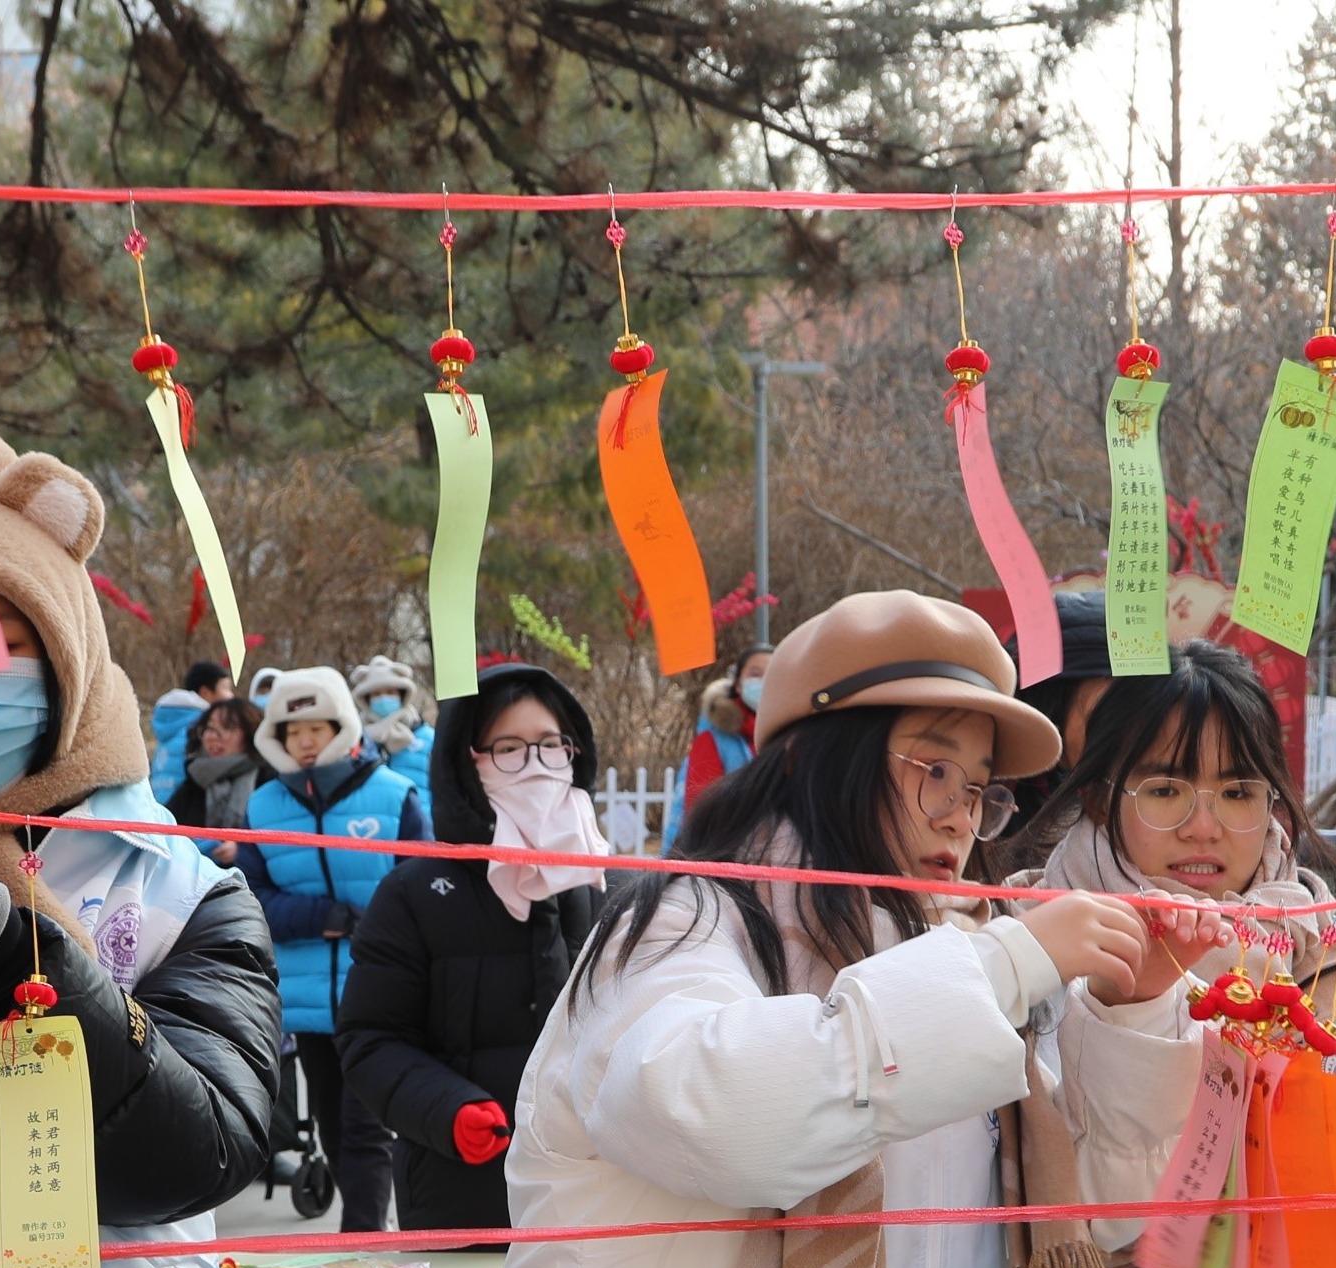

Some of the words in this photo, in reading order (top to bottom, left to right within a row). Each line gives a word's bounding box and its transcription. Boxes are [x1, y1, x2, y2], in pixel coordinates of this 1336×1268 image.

[1269, 448, 1300, 566] 半夜爱把歌来唱
[1282, 453, 1319, 572] 有种鸟儿真奇怪
[0, 1062, 45, 1078] 猜灯谜
[27, 1111, 43, 1193] 故来相决绝
[45, 1108, 63, 1192] 闻君有两意
[28, 1232, 65, 1242] 编号3739
